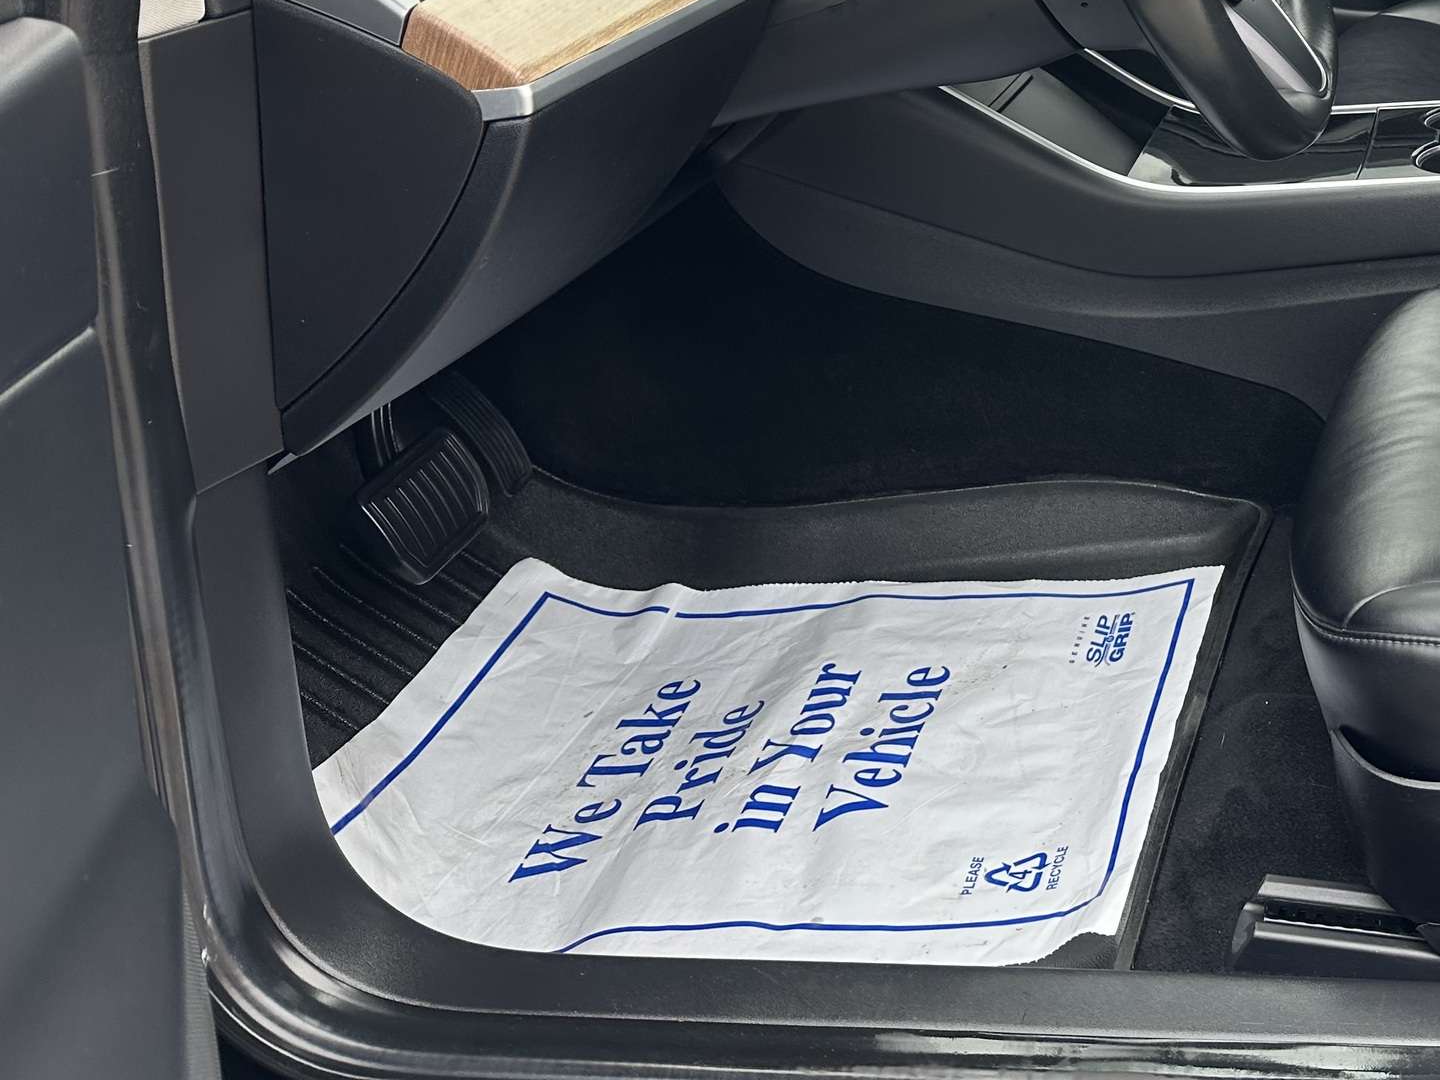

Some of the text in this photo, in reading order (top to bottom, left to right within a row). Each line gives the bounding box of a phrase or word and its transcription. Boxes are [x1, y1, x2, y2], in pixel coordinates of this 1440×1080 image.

[1069, 616, 1090, 664] GENUINE
[1086, 614, 1111, 663] SLIP
[1109, 612, 1133, 663] GRIP
[634, 700, 765, 831] Pride
[713, 663, 862, 834] in Your
[813, 665, 951, 832] Vehicle
[508, 679, 700, 884] We Take
[960, 856, 985, 896] PLEASE
[1046, 846, 1069, 891] RECYCLE
